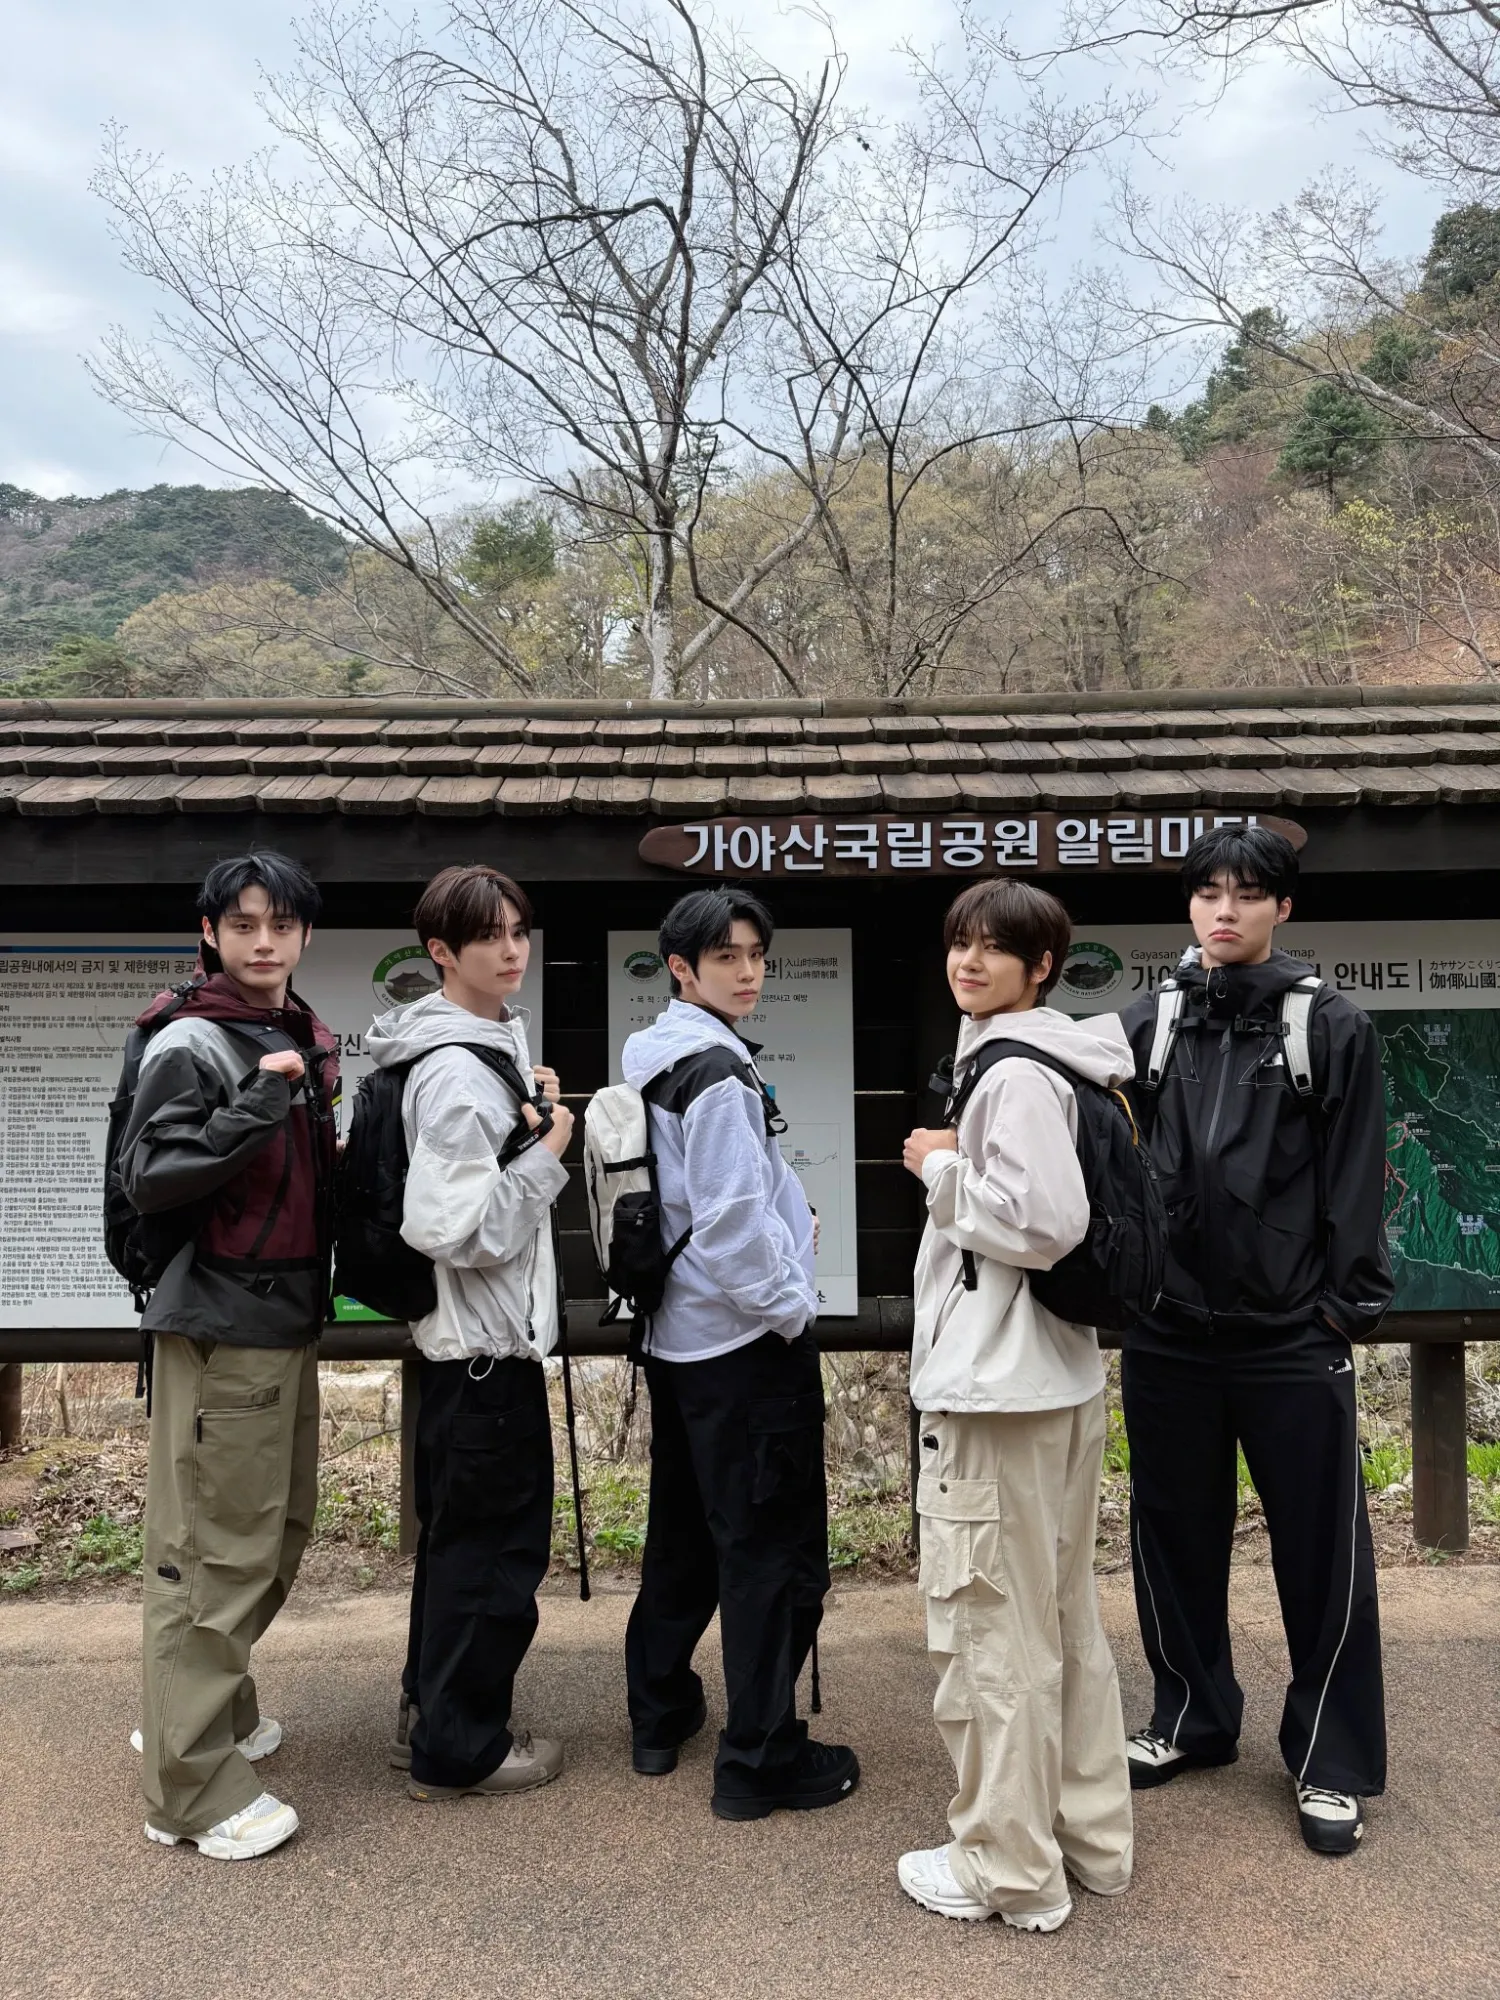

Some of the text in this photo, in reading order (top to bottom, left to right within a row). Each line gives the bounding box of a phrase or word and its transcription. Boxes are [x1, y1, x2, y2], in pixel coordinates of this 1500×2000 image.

[683, 818, 1037, 871] 가야산국립공원
[1130, 949, 1178, 962] Gayasan
[81, 960, 104, 974] 금지
[109, 960, 120, 974] 및
[124, 960, 170, 974] 제한행위
[1334, 962, 1410, 991] 안내도
[1429, 972, 1500, 990] 伽倻山國
[761, 994, 808, 1003] 안전사고 예방
